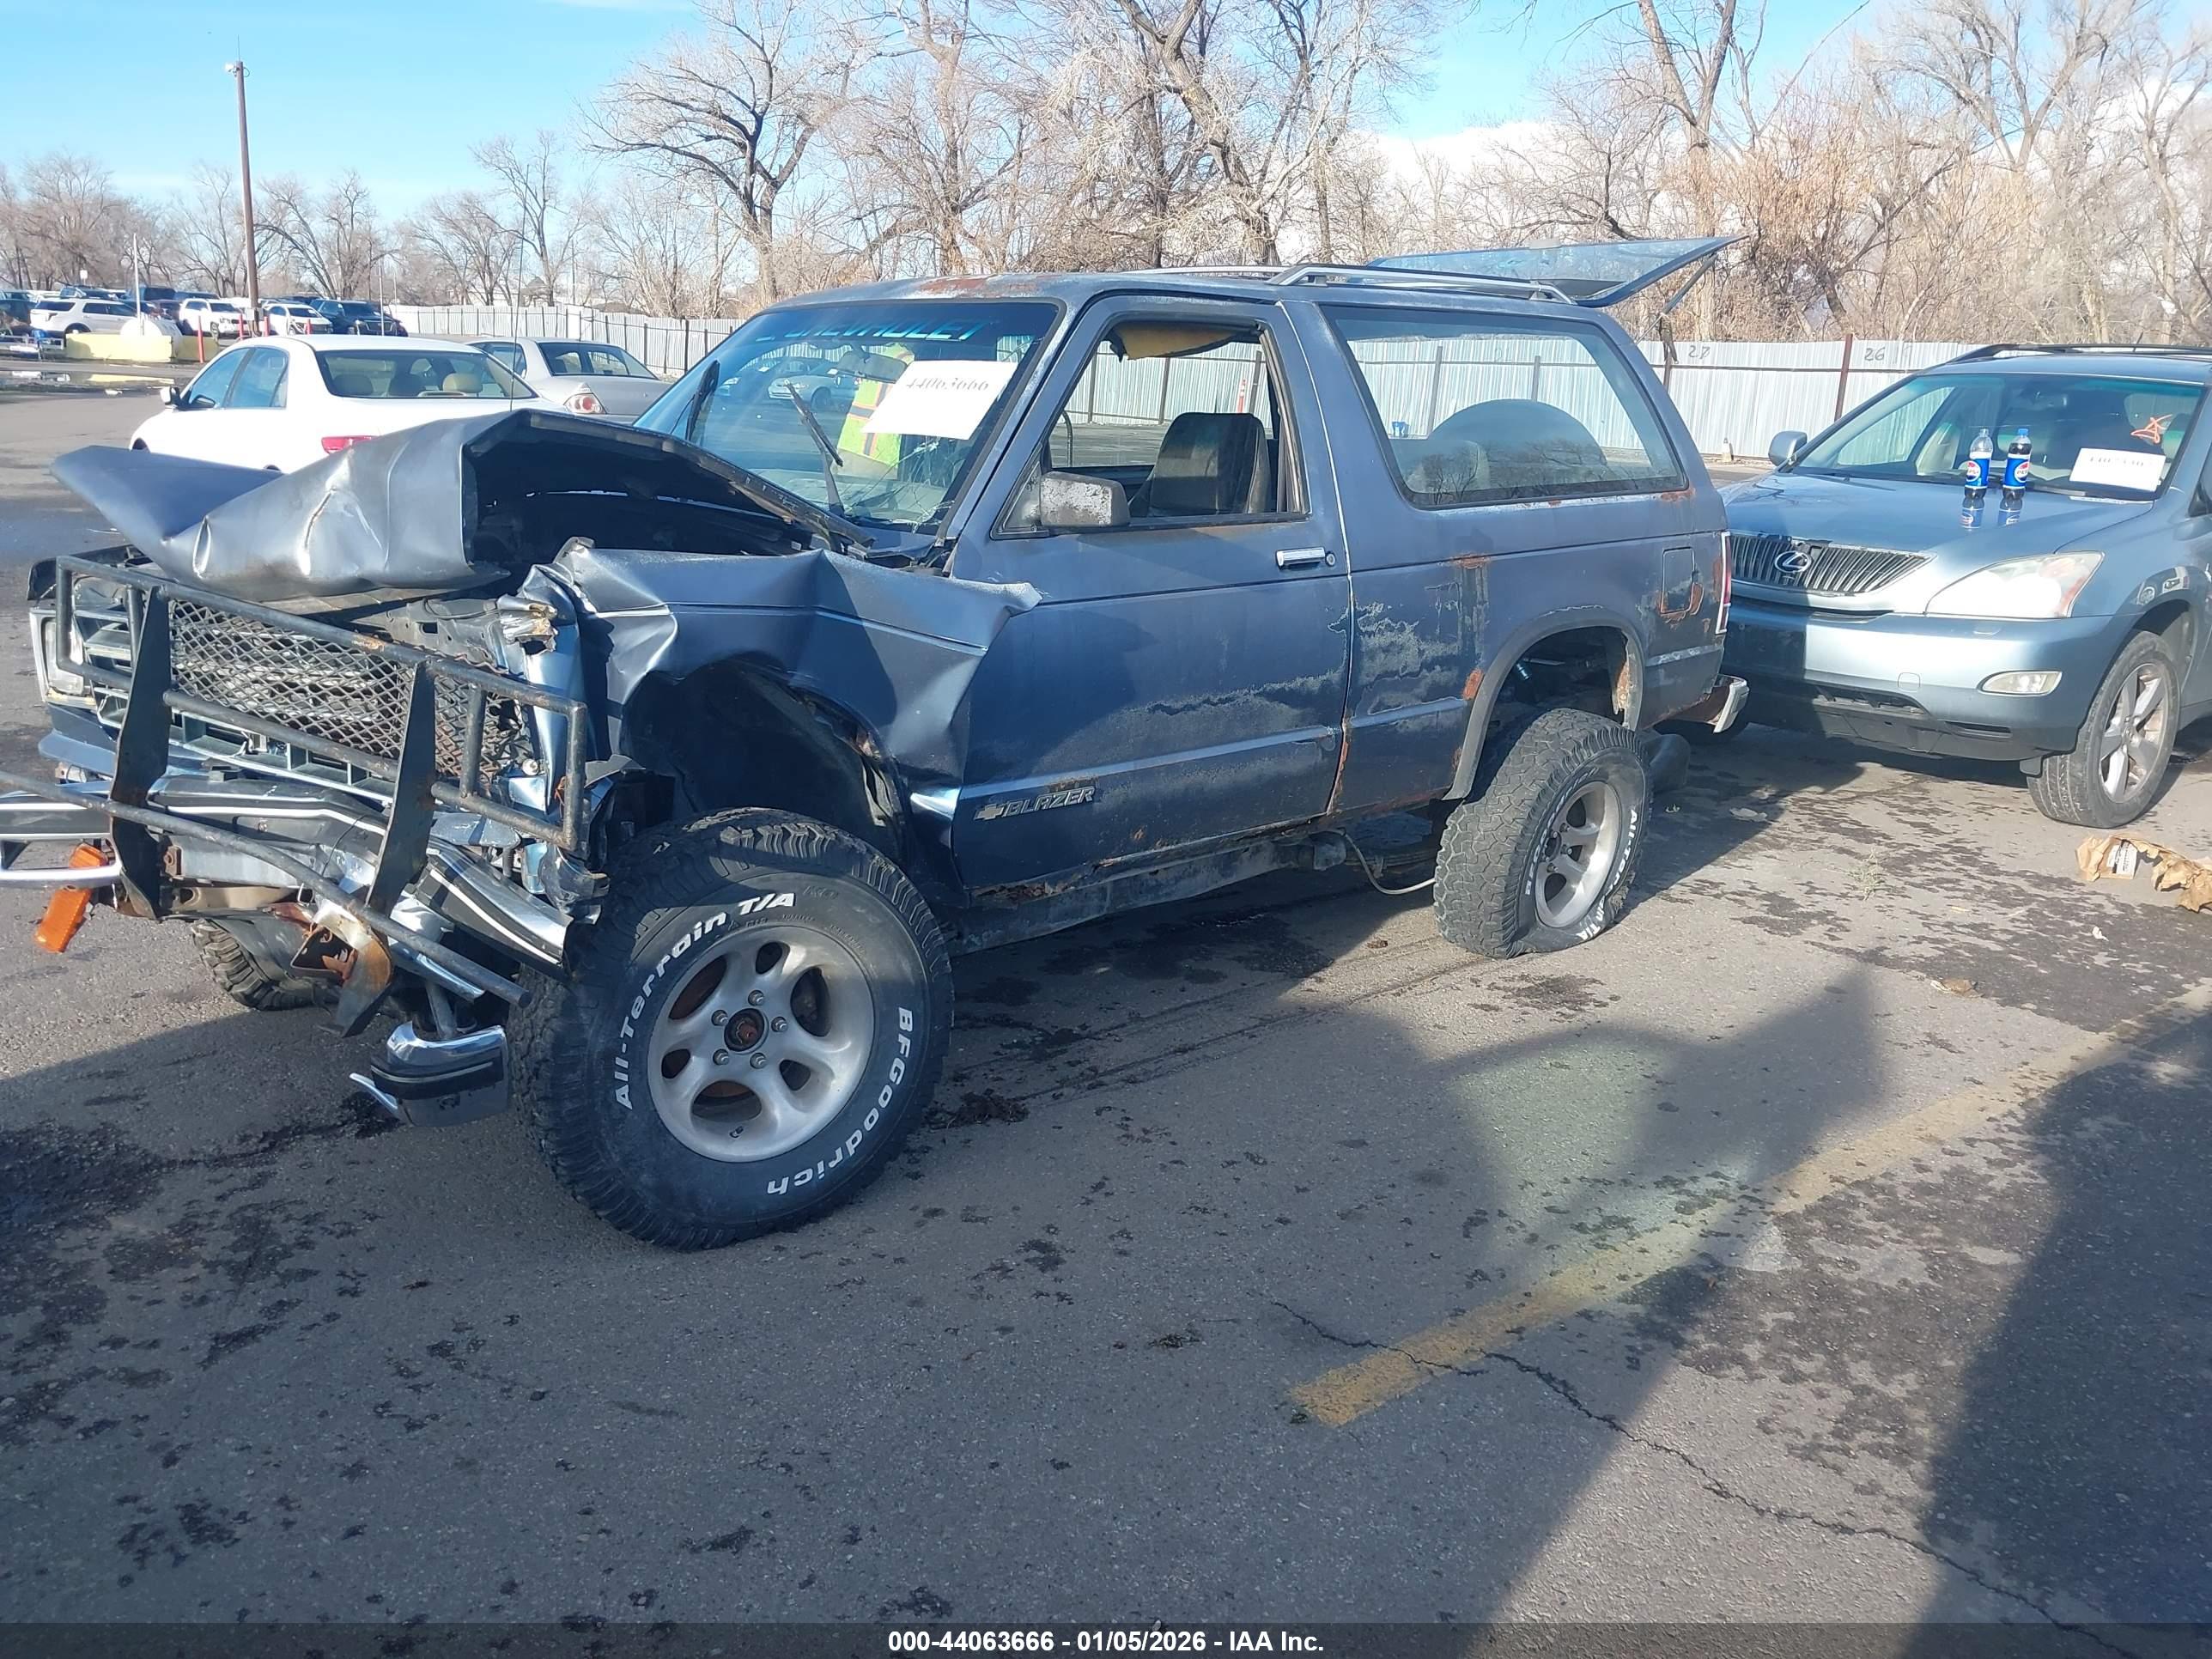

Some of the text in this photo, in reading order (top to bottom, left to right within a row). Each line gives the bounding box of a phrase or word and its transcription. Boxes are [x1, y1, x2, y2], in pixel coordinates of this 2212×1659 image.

[1864, 346, 1886, 362] 26
[1001, 786, 1096, 817] BLAZER
[613, 911, 727, 1111] All-Terrain
[738, 892, 797, 916] T/A
[767, 1006, 915, 1195] BFGoodrich
